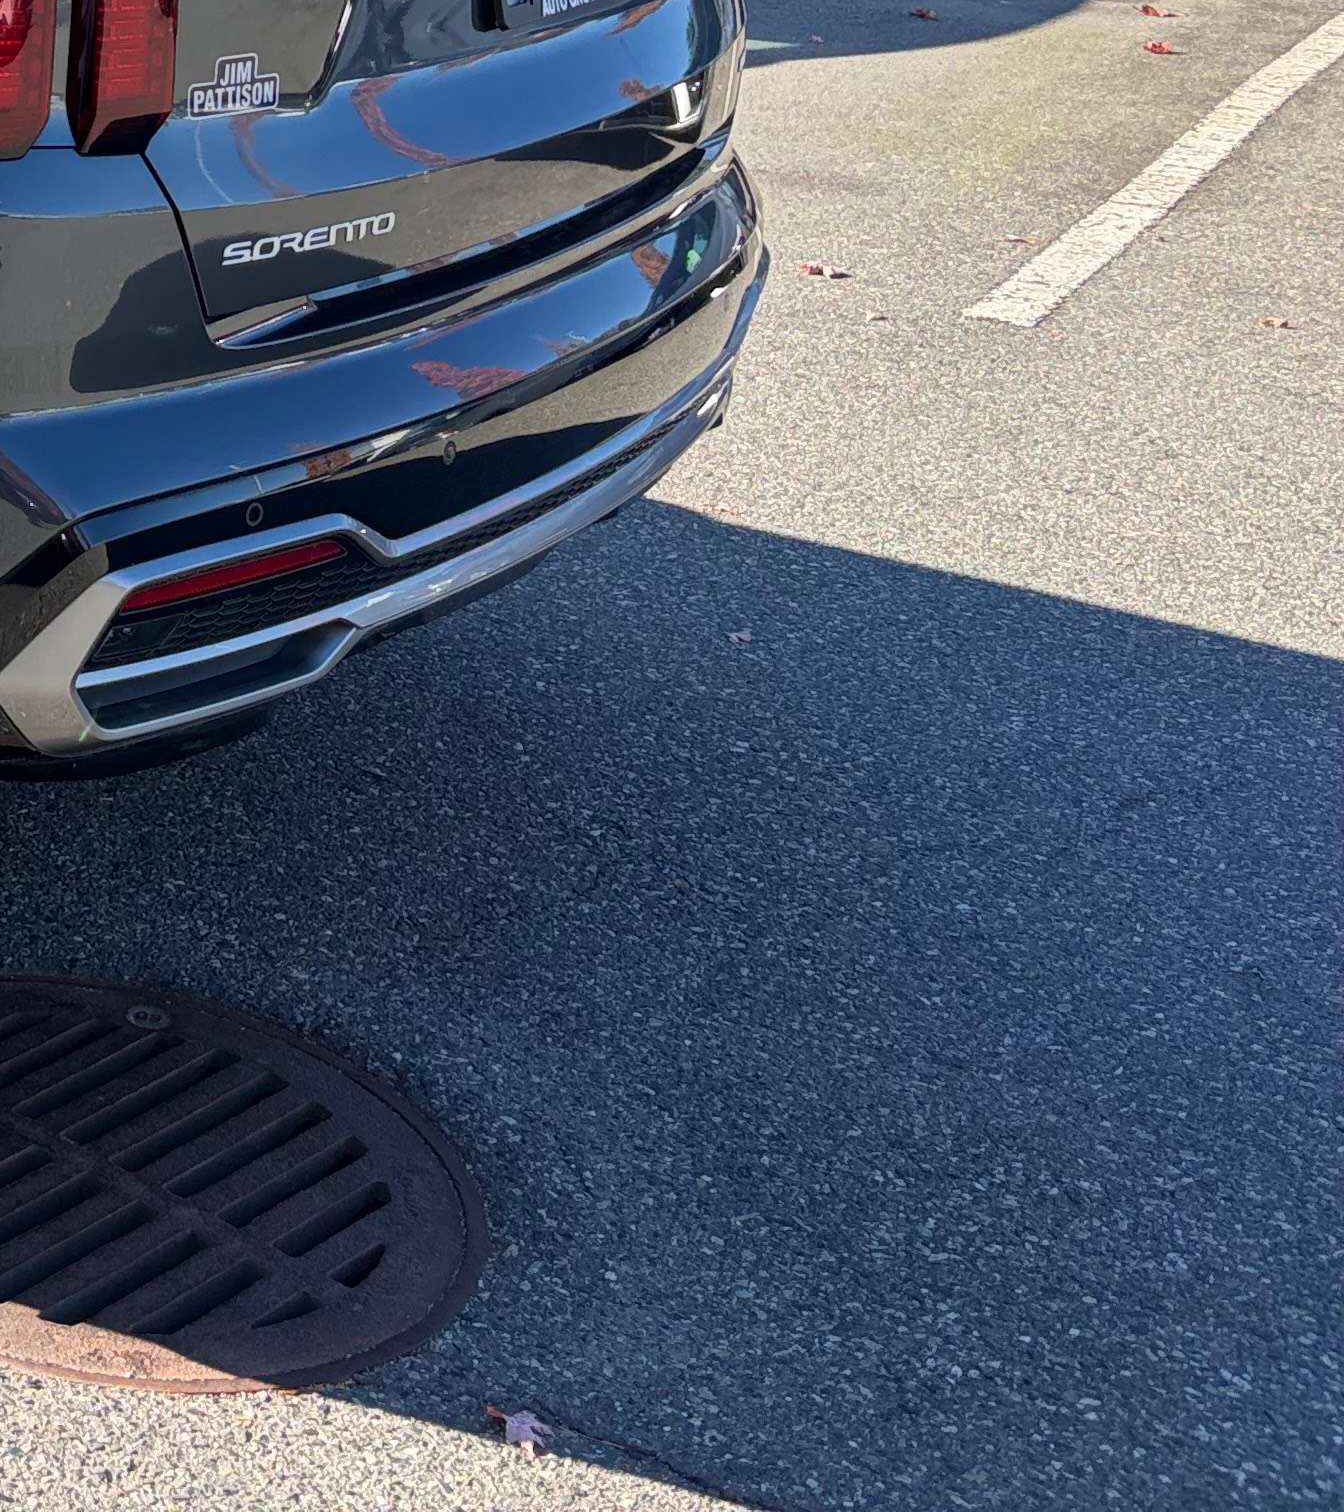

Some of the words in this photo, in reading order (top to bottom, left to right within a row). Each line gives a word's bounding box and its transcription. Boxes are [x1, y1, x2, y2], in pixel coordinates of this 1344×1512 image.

[219, 60, 252, 87] JIM
[193, 80, 275, 114] PATTISON
[221, 211, 396, 267] SORENTO
